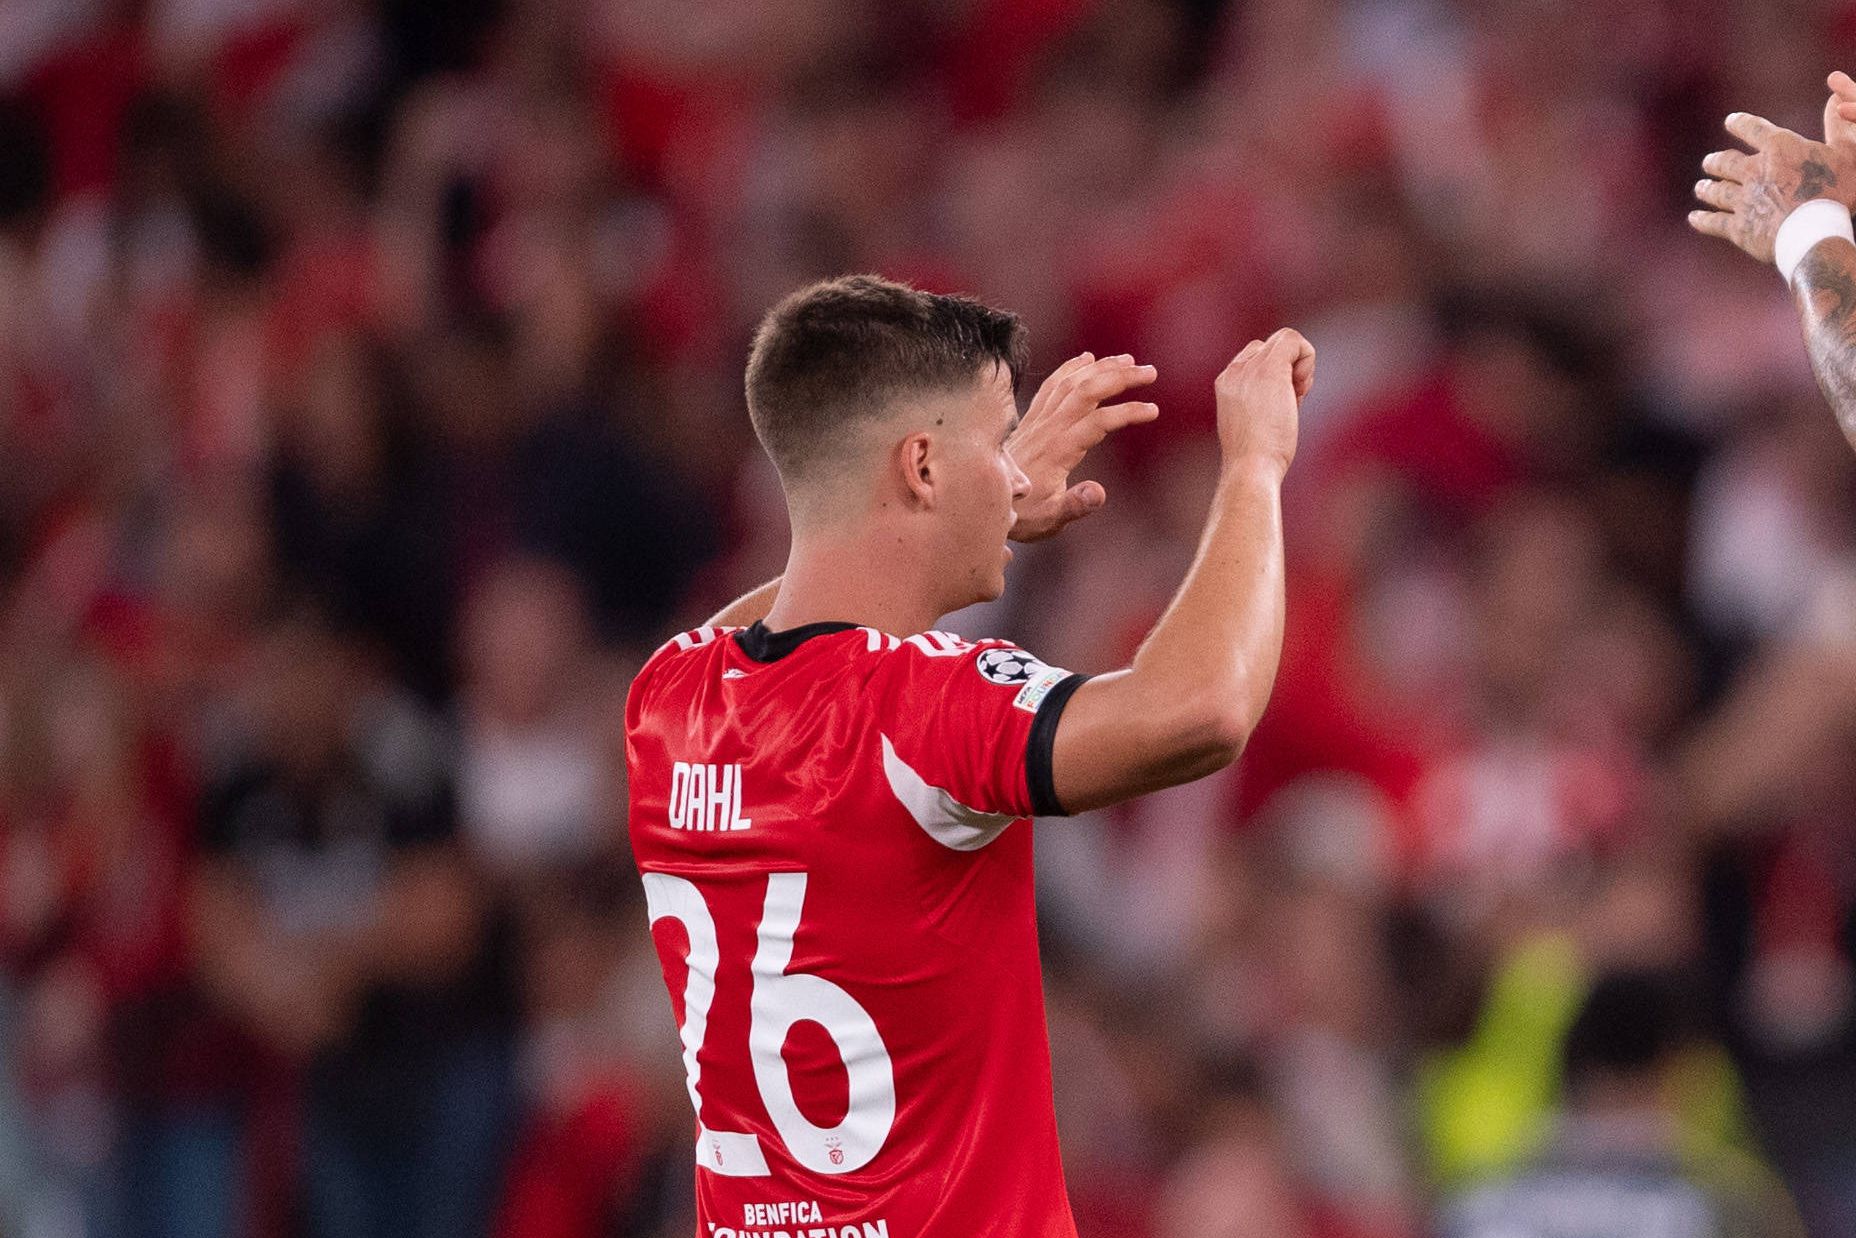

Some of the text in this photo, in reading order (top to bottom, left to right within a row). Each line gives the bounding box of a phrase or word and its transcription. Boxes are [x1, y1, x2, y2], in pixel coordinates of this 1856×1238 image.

[668, 761, 752, 832] DAHL
[641, 872, 896, 1177] 26
[744, 1200, 823, 1226] BENFICA
